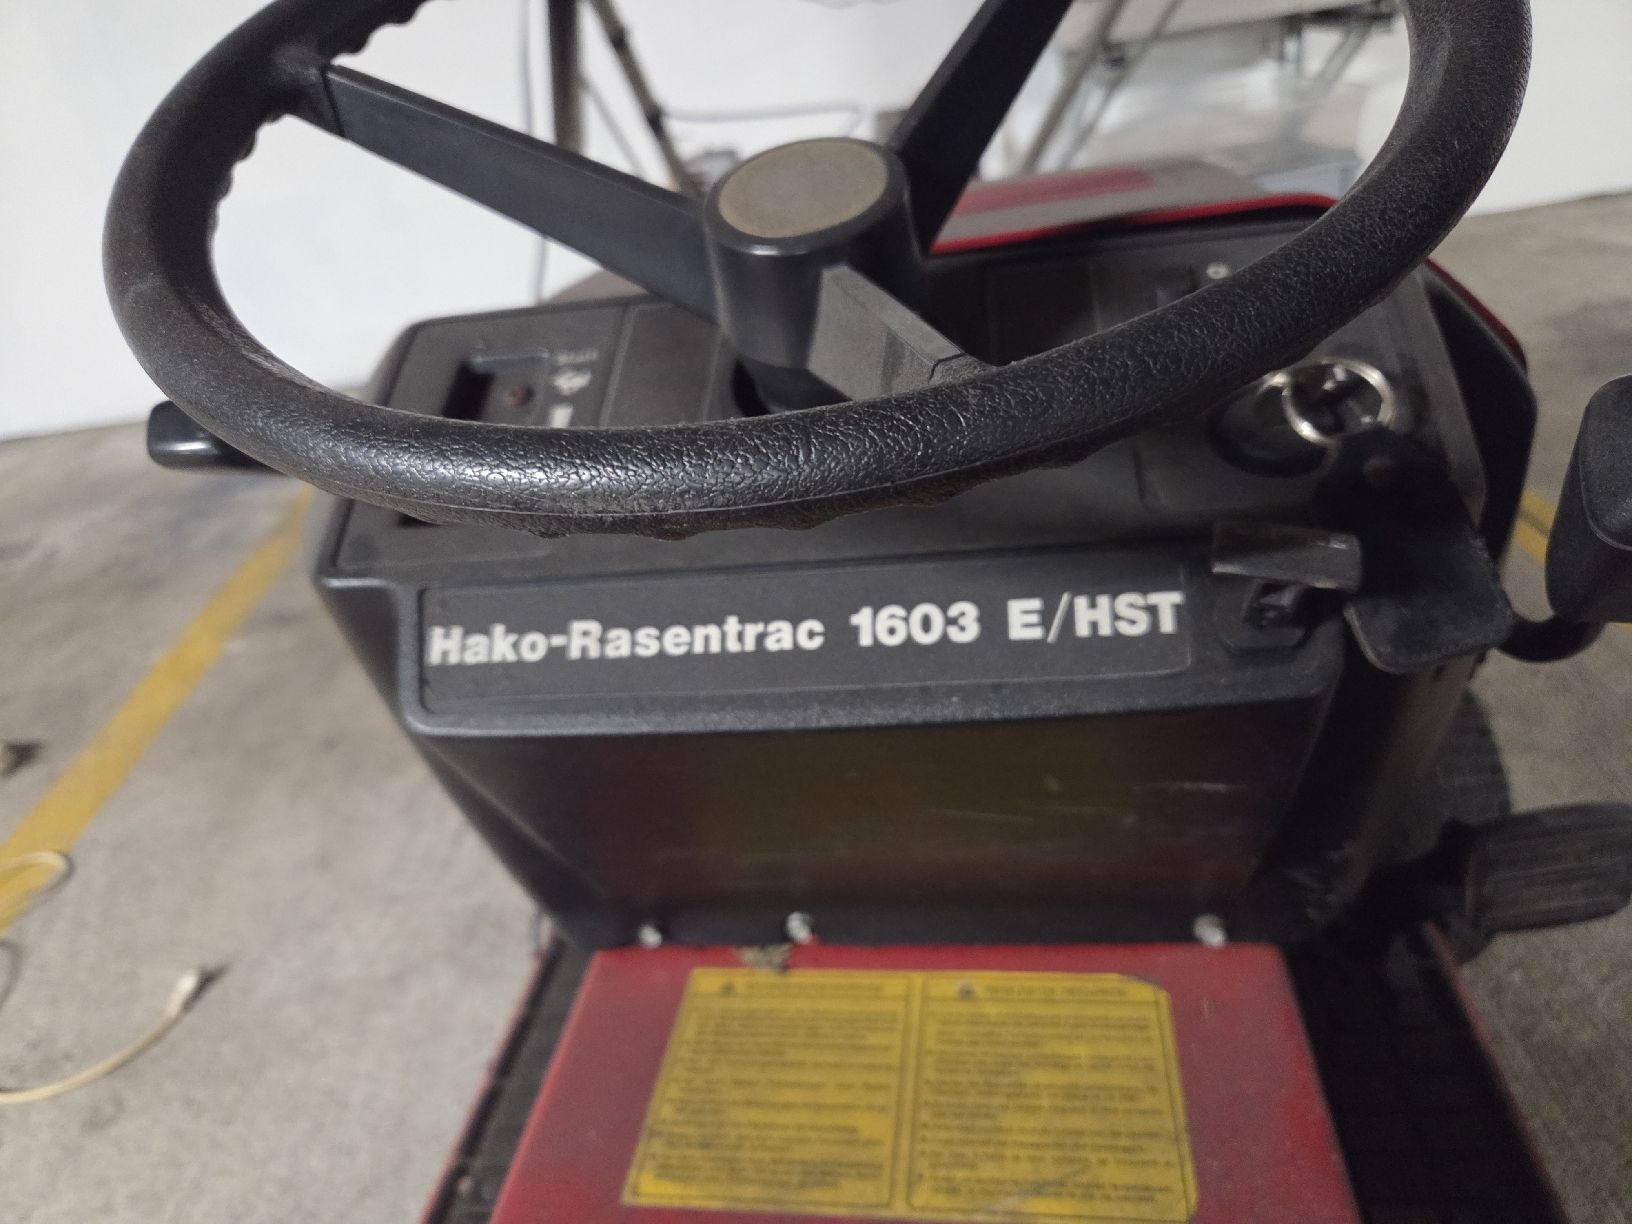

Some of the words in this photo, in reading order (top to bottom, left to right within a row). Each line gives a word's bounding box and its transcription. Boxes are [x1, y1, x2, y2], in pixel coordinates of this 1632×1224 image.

[427, 615, 825, 666] Hako-Rasentrac
[849, 601, 981, 647] 1603
[1007, 591, 1186, 643] E/HST
